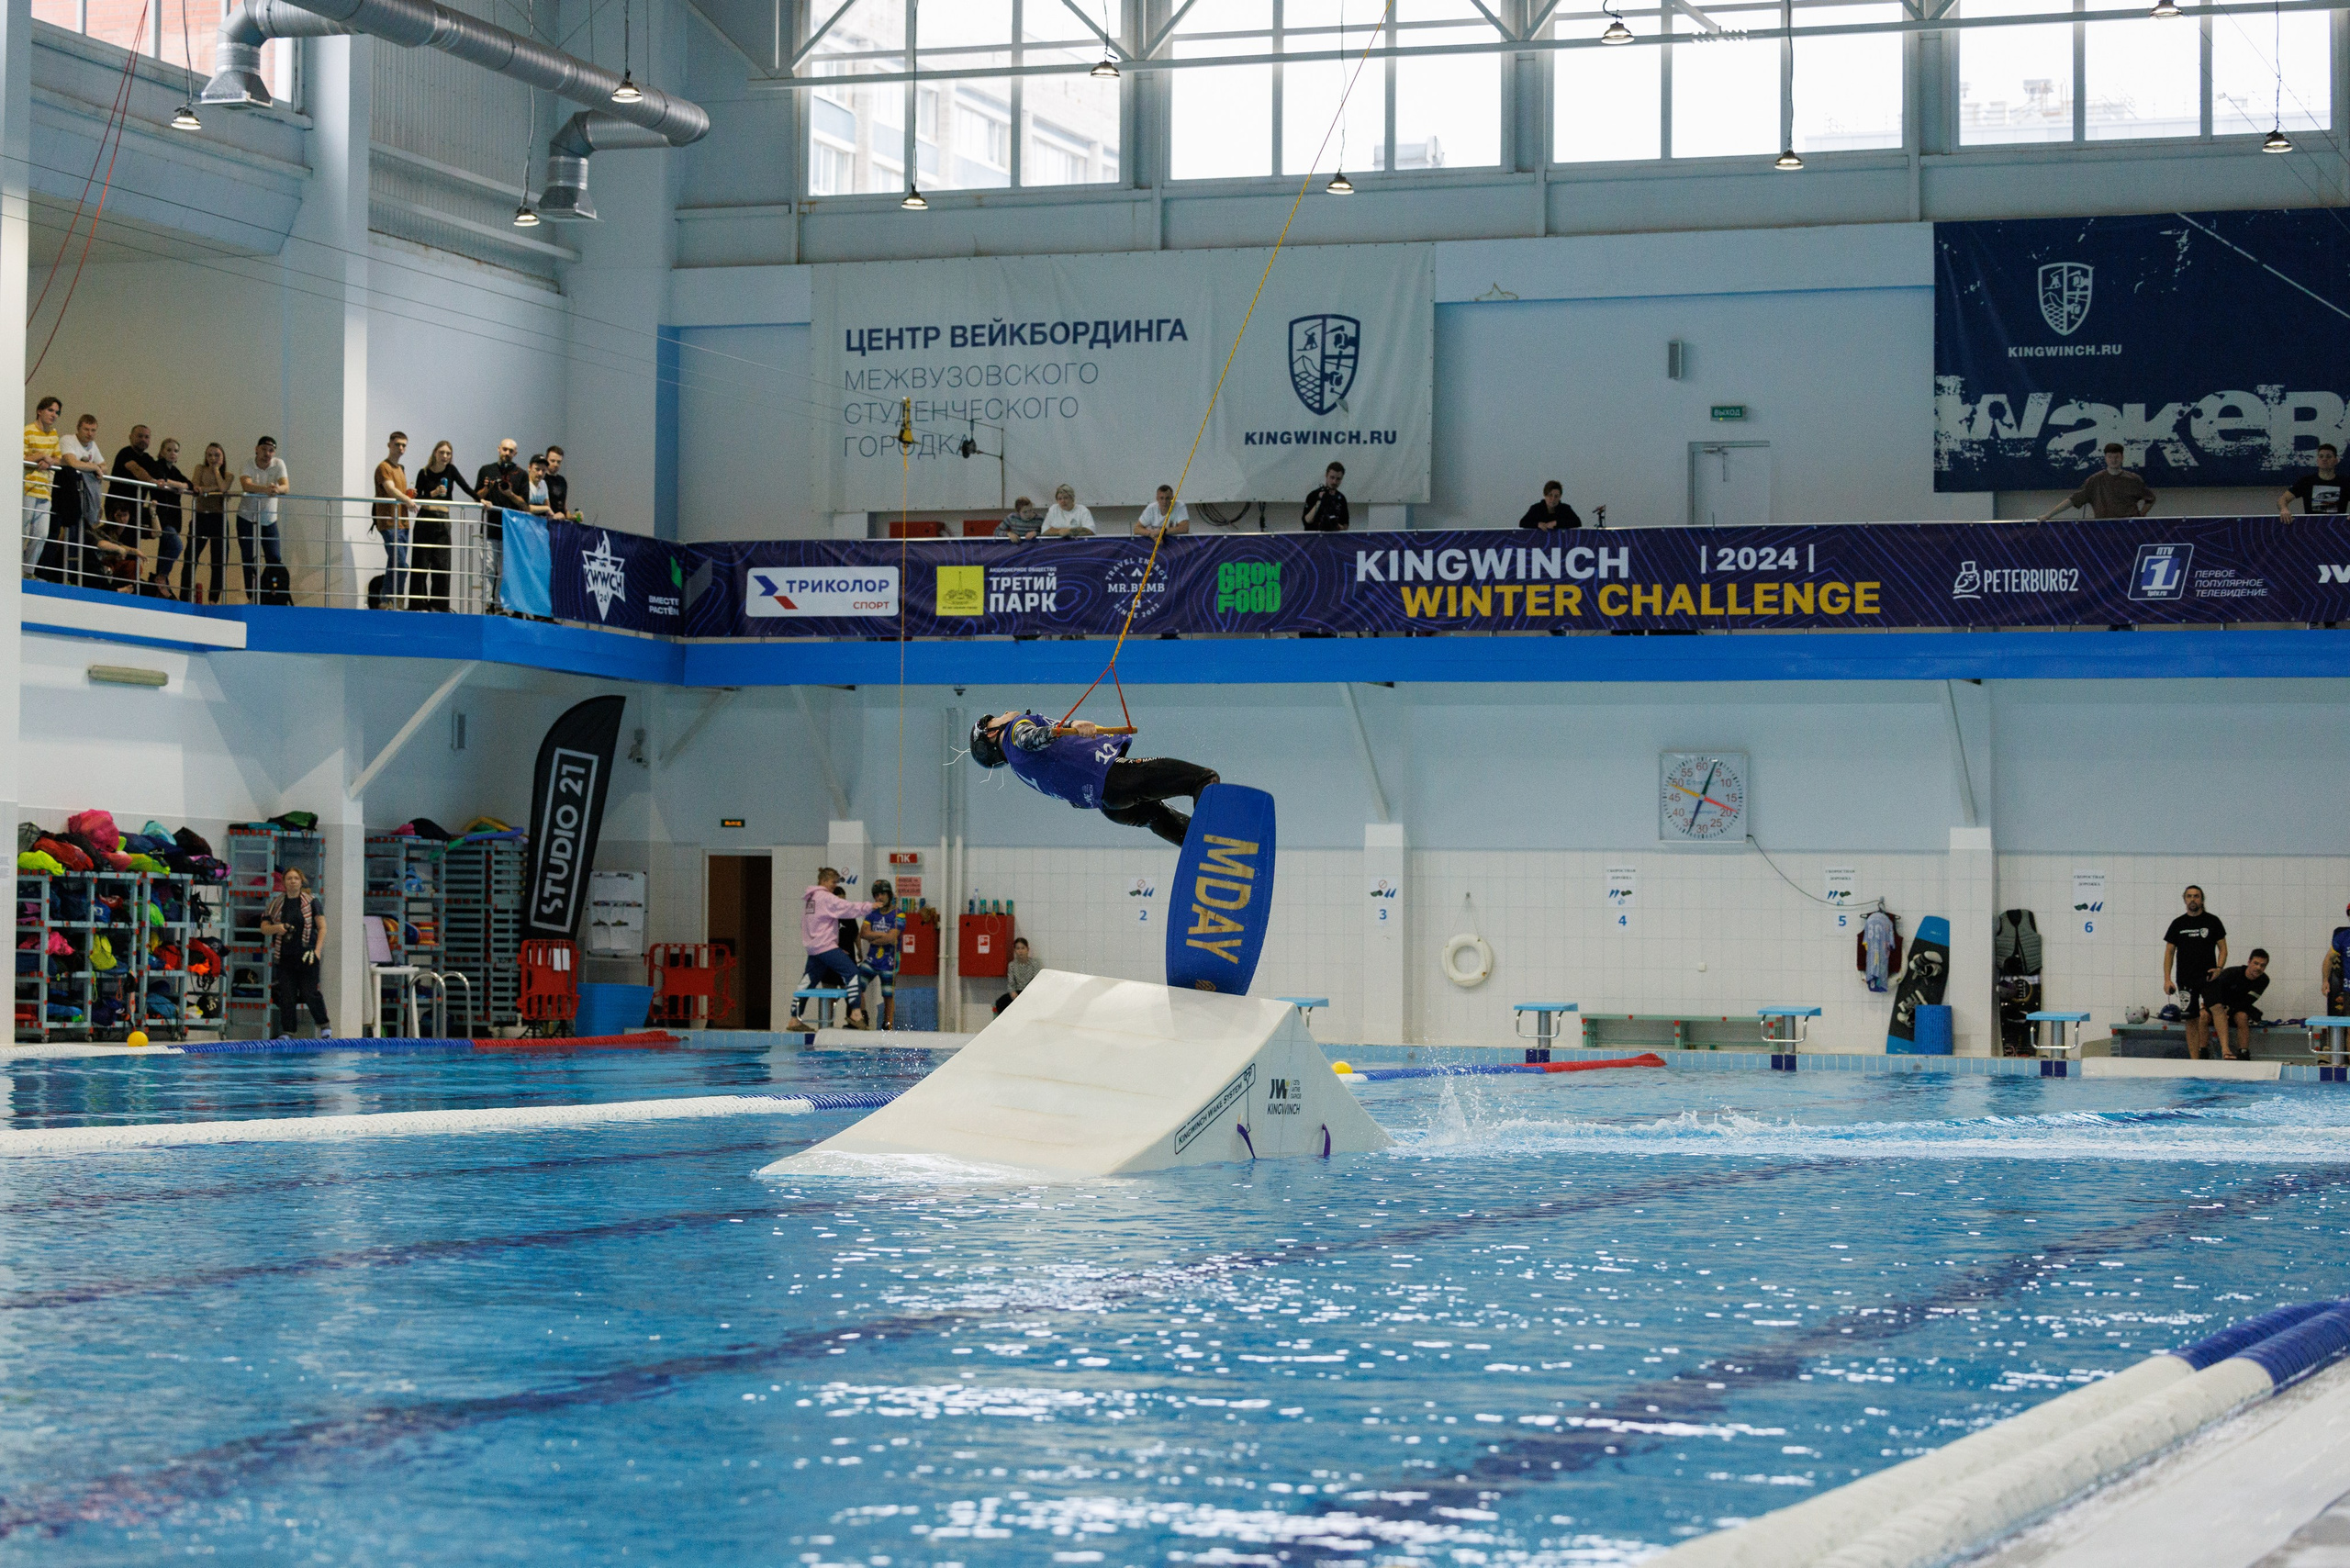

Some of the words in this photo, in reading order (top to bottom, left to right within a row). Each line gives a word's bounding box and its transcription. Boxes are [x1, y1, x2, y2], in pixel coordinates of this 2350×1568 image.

[845, 325, 941, 356] ЦЕНТР
[950, 317, 1189, 350] ВЕЙКБОРДИНГА
[2008, 344, 2122, 358] KINGWINCH.RU
[845, 362, 1099, 391] МЕЖВУЗОВСКОГО
[845, 397, 1079, 427] СТУДЕНЧЕСКОГО
[1244, 429, 1397, 446] KINGWINCH.RU
[1104, 557, 1136, 581] TRAVEL
[1356, 545, 1630, 582] KINGWINCH
[1217, 561, 1282, 594] GROW
[2194, 569, 2236, 578] ПЕРВОЕ
[786, 578, 890, 594] ТРИКОЛОР
[989, 572, 1058, 591] ТРЕТИЙ
[1984, 567, 2079, 593] PETERBURG2
[2194, 578, 2264, 588] ПОПУЛЯРНОЕ
[1217, 581, 1281, 613] FOOD
[2195, 588, 2268, 598] ТЕЛЕВИДЕНИЕ
[648, 595, 679, 606] ВМЕСТЕ
[853, 600, 890, 610] СПОРТ
[989, 592, 1058, 612] ПАРК
[1401, 583, 1583, 619] WINTER
[1597, 580, 1881, 617] CHALLENGE
[1695, 761, 1708, 771] 60
[1681, 768, 1693, 778] 55
[1715, 768, 1722, 778] 5
[559, 763, 586, 797] 21
[1672, 778, 1684, 788] 50
[1720, 778, 1732, 788] 10
[1668, 793, 1681, 802] 45
[1726, 793, 1738, 802] 15
[1672, 808, 1684, 817] 40
[1719, 808, 1732, 817] 20
[1695, 824, 1708, 834] 30
[1710, 818, 1723, 828] 25
[541, 804, 578, 915] STUDIO
[896, 854, 911, 863] ПК
[1185, 834, 1259, 964] MDAY
[1139, 909, 1147, 921] 2
[1379, 908, 1387, 920] 3
[1618, 914, 1628, 926] 4
[1838, 914, 1847, 926] 5
[2085, 921, 2094, 933] 6
[1178, 1113, 1208, 1146] KINGWINCH
[1207, 1101, 1224, 1119] WAKE
[1223, 1081, 1243, 1104] SYSTEM
[1267, 1103, 1301, 1114] KINGWINCH
